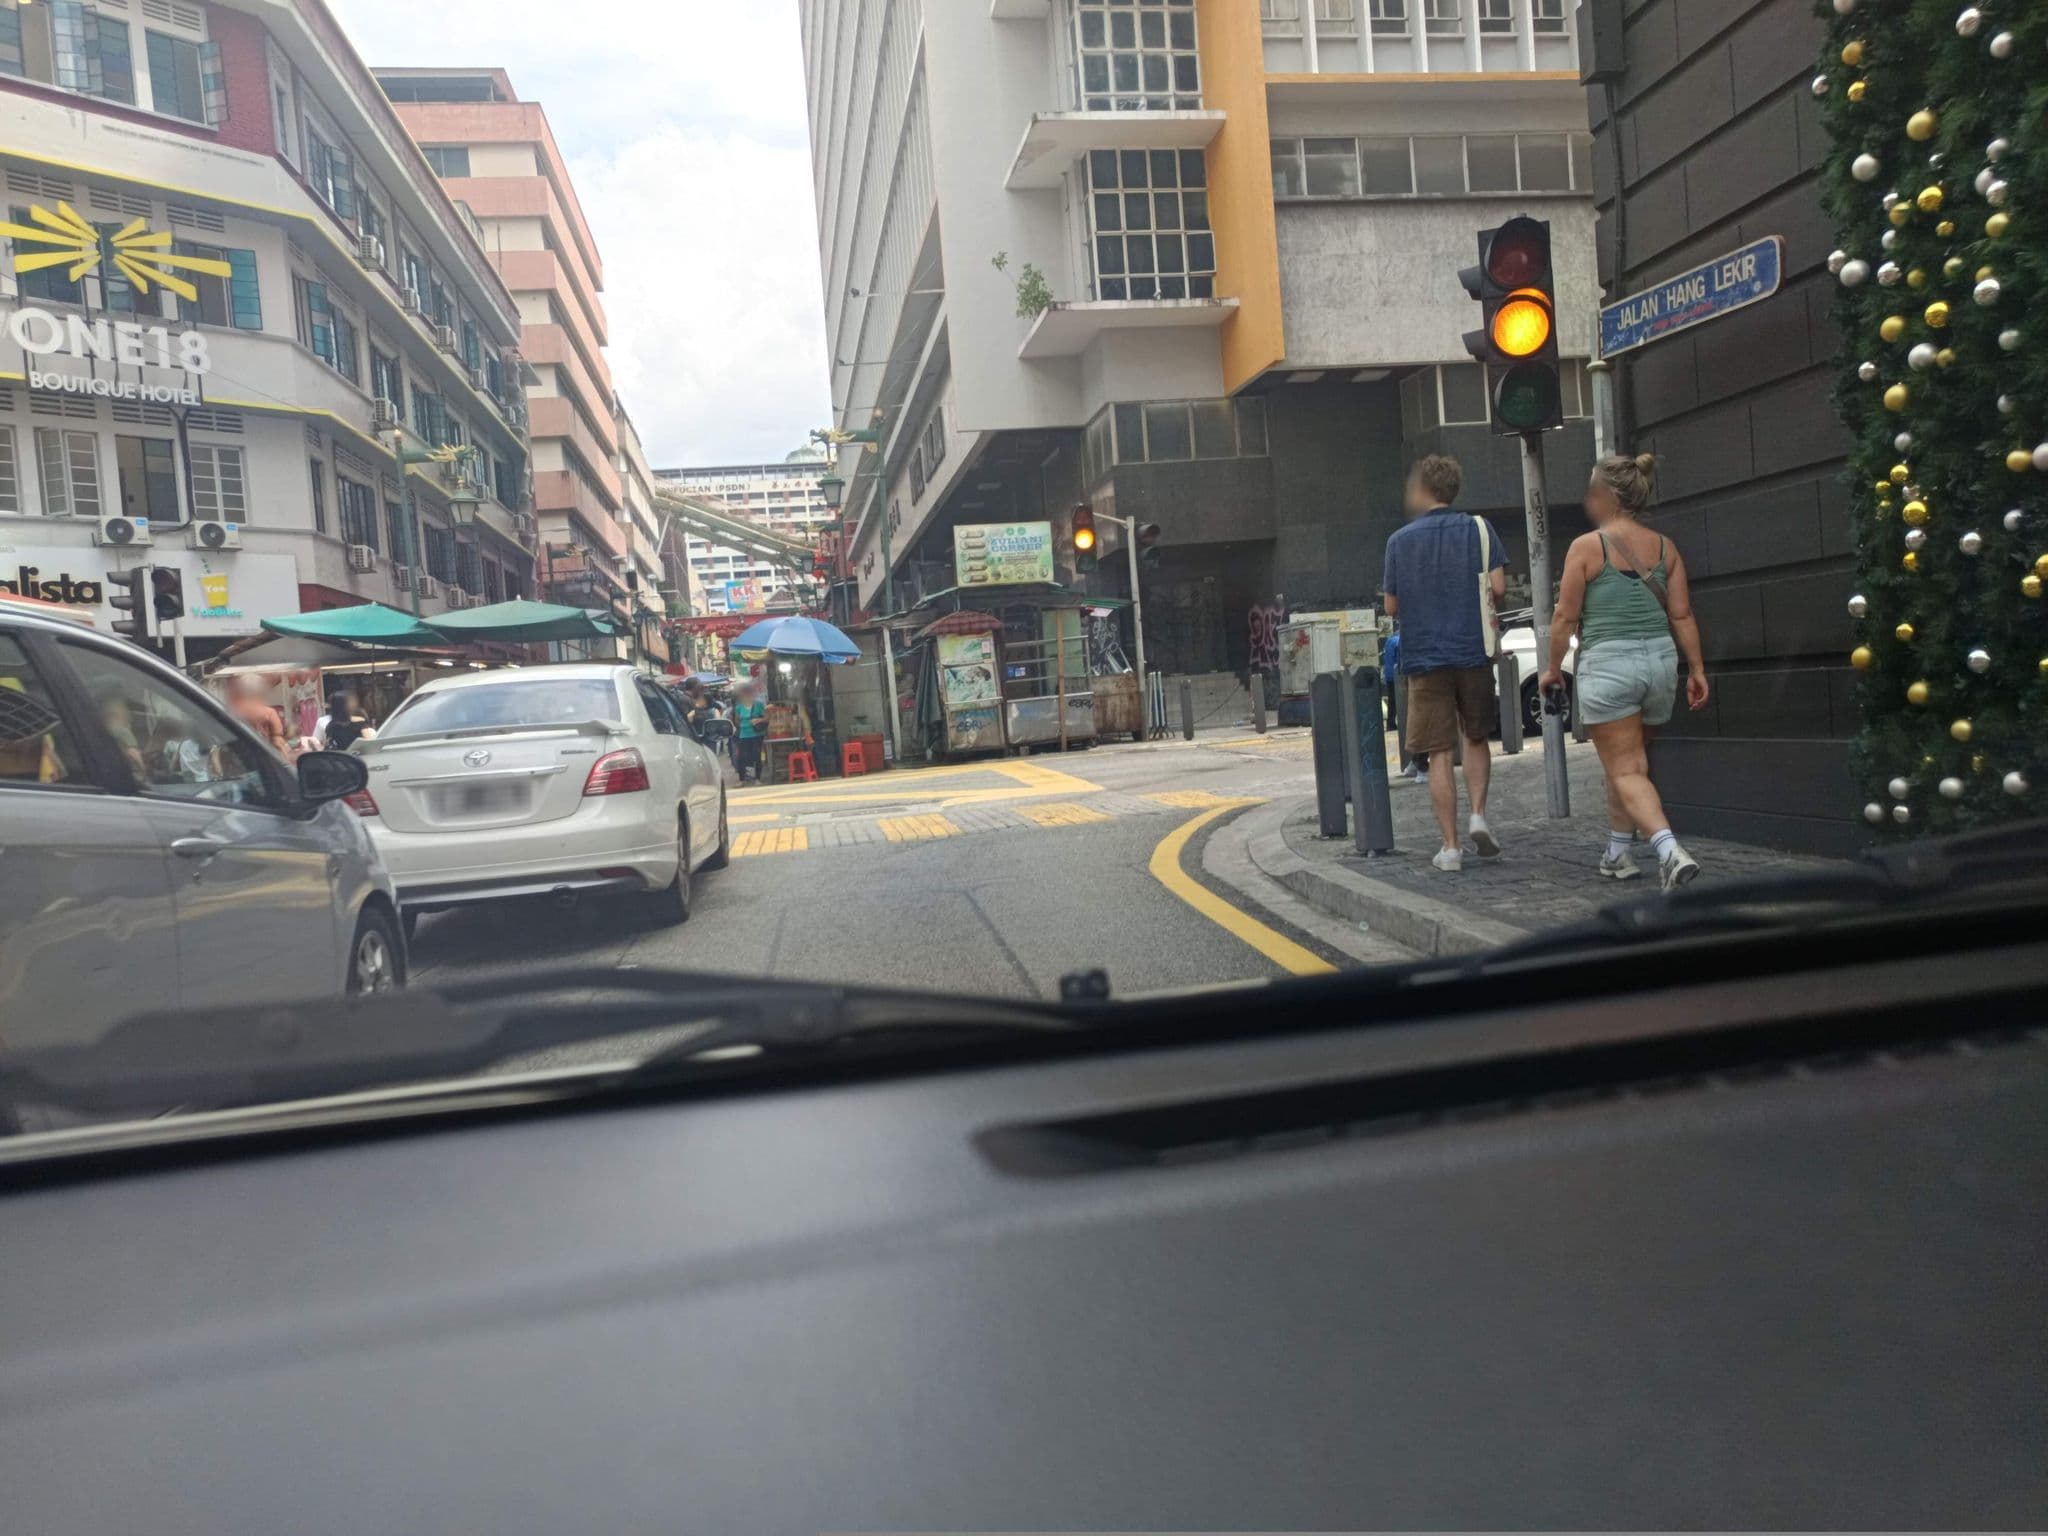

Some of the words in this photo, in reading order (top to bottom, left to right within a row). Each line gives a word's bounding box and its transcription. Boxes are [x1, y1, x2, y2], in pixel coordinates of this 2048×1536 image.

[1617, 294, 1659, 331] JALAN
[1666, 276, 1706, 312] HANG
[1714, 254, 1756, 292] LEKIR
[10, 307, 212, 375] ONE18
[29, 370, 137, 400] BOUTIQUE
[140, 383, 202, 406] HOTEL
